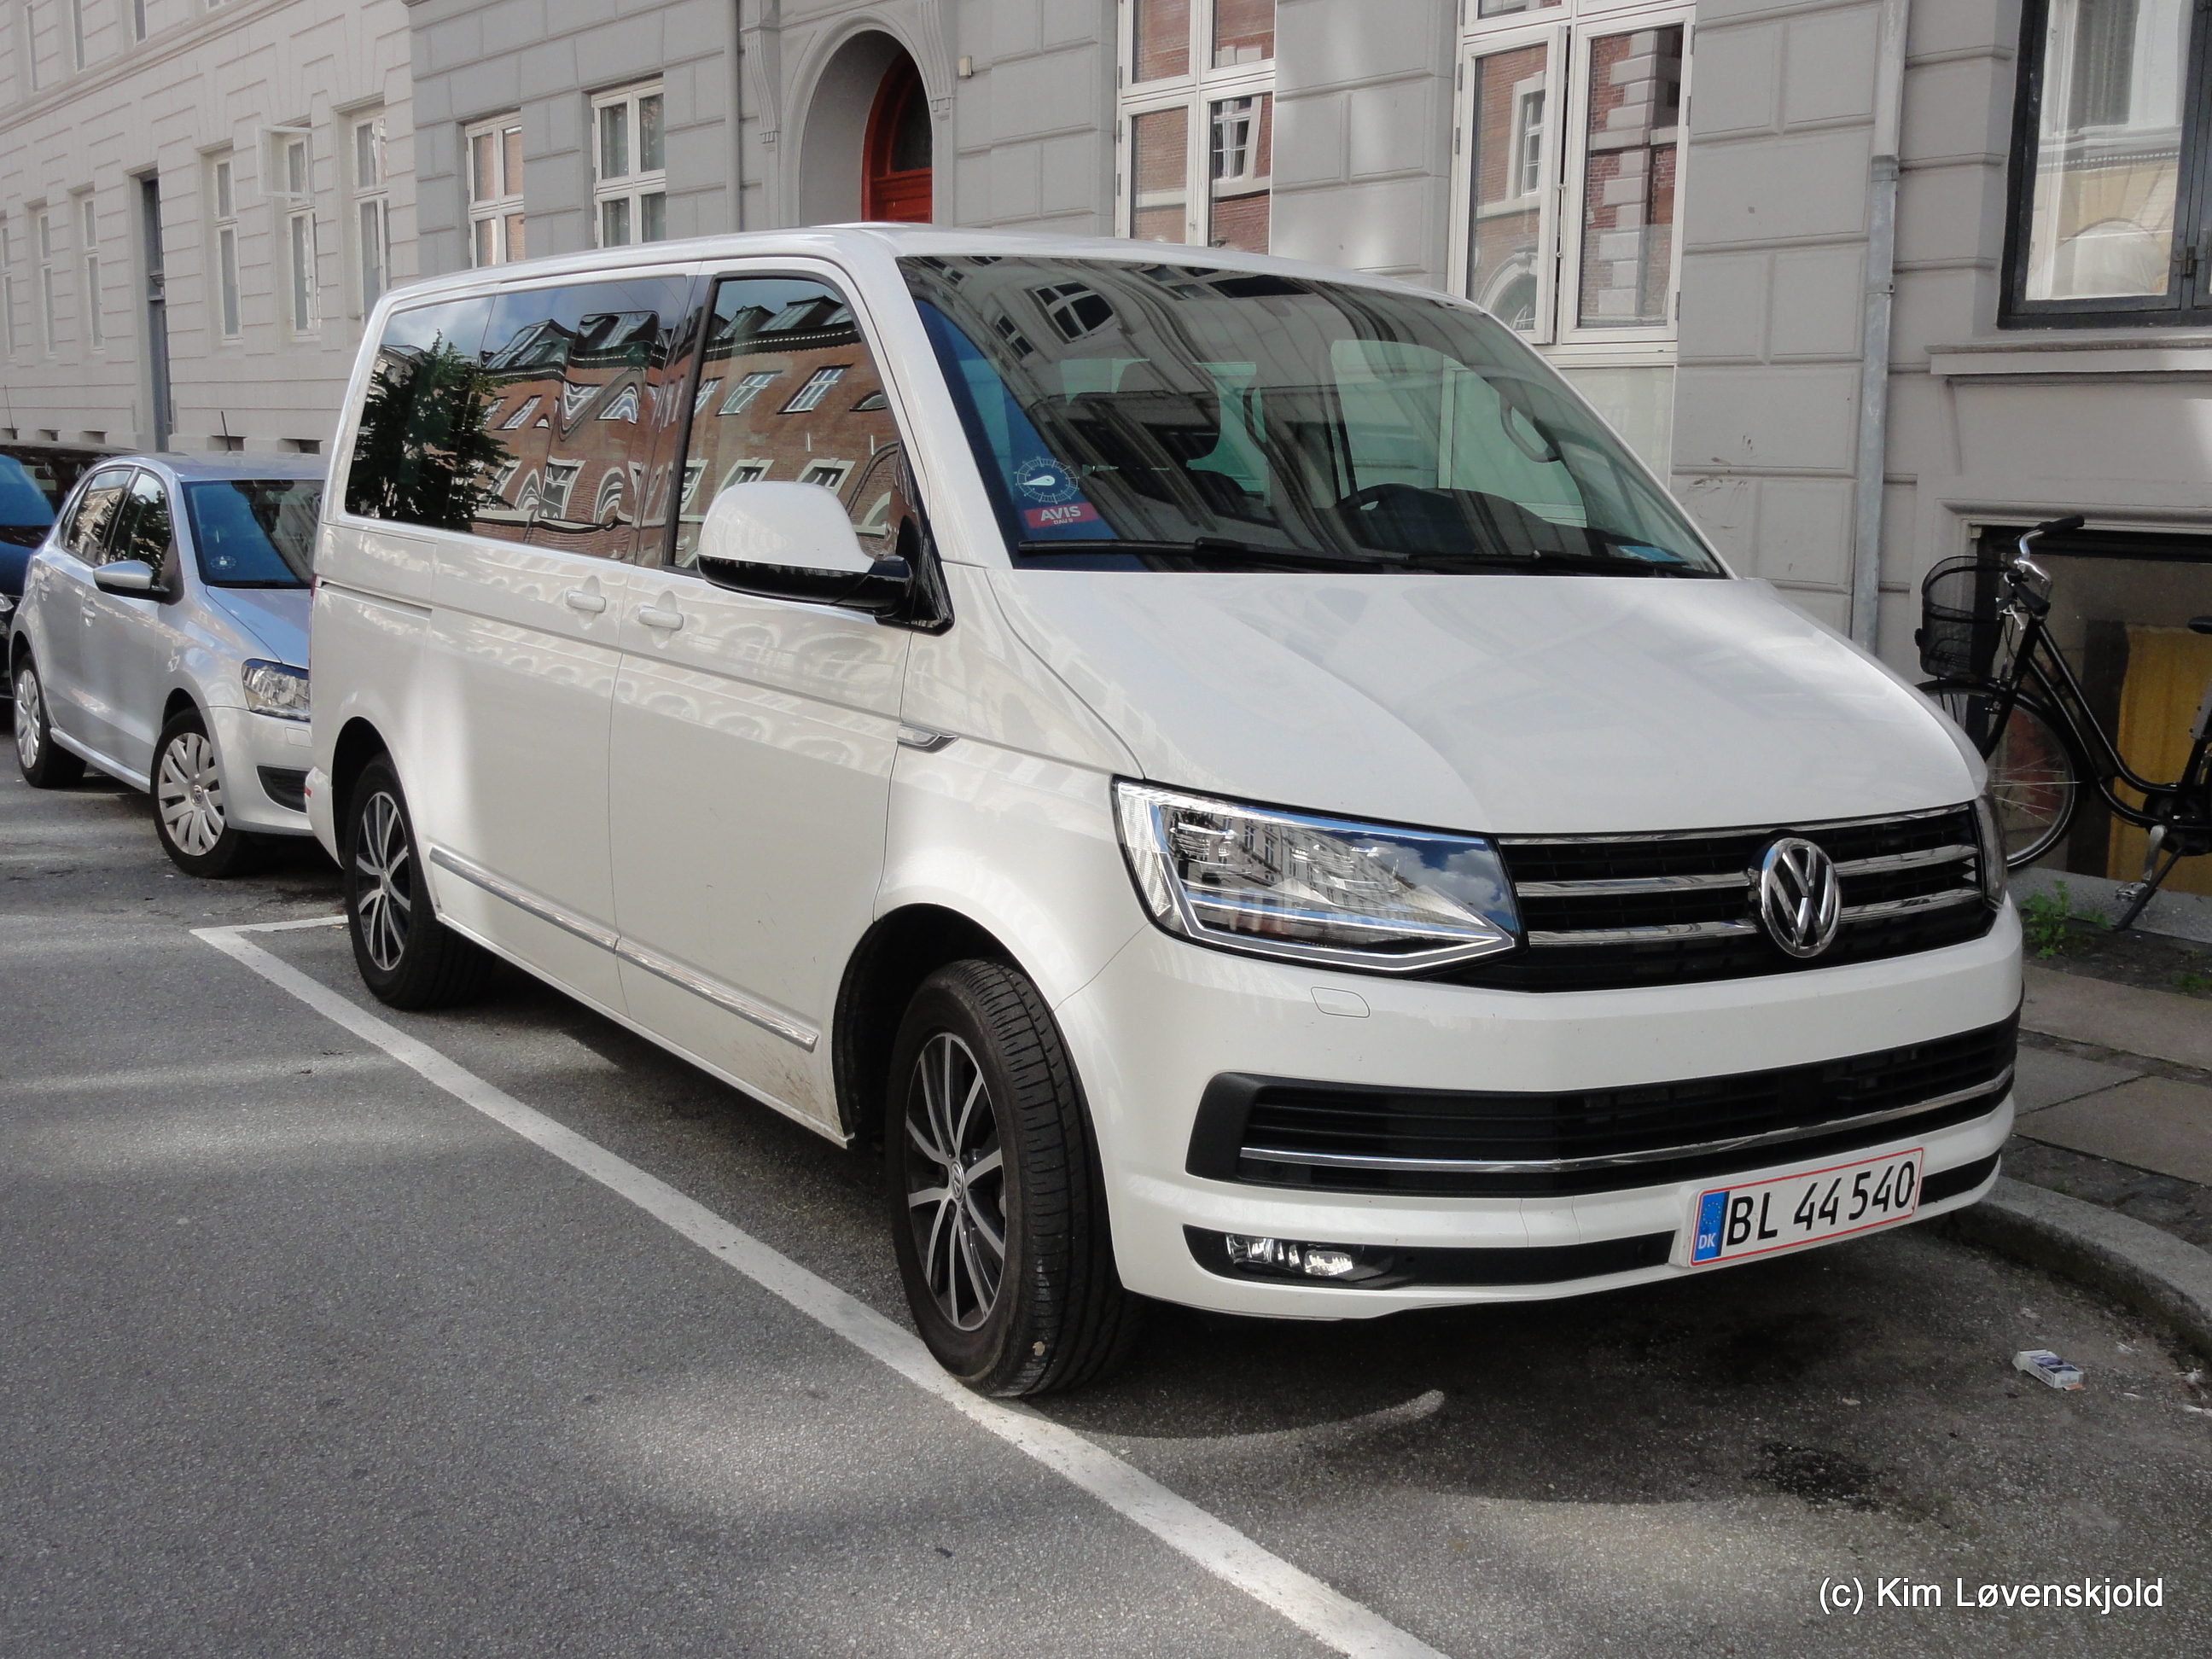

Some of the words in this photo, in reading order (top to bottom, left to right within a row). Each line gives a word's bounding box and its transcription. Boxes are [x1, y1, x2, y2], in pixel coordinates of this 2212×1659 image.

[1041, 506, 1081, 521] AVIS
[1763, 839, 1840, 955] VW
[1726, 1192, 1778, 1247] BL
[1698, 1232, 1717, 1250] DK
